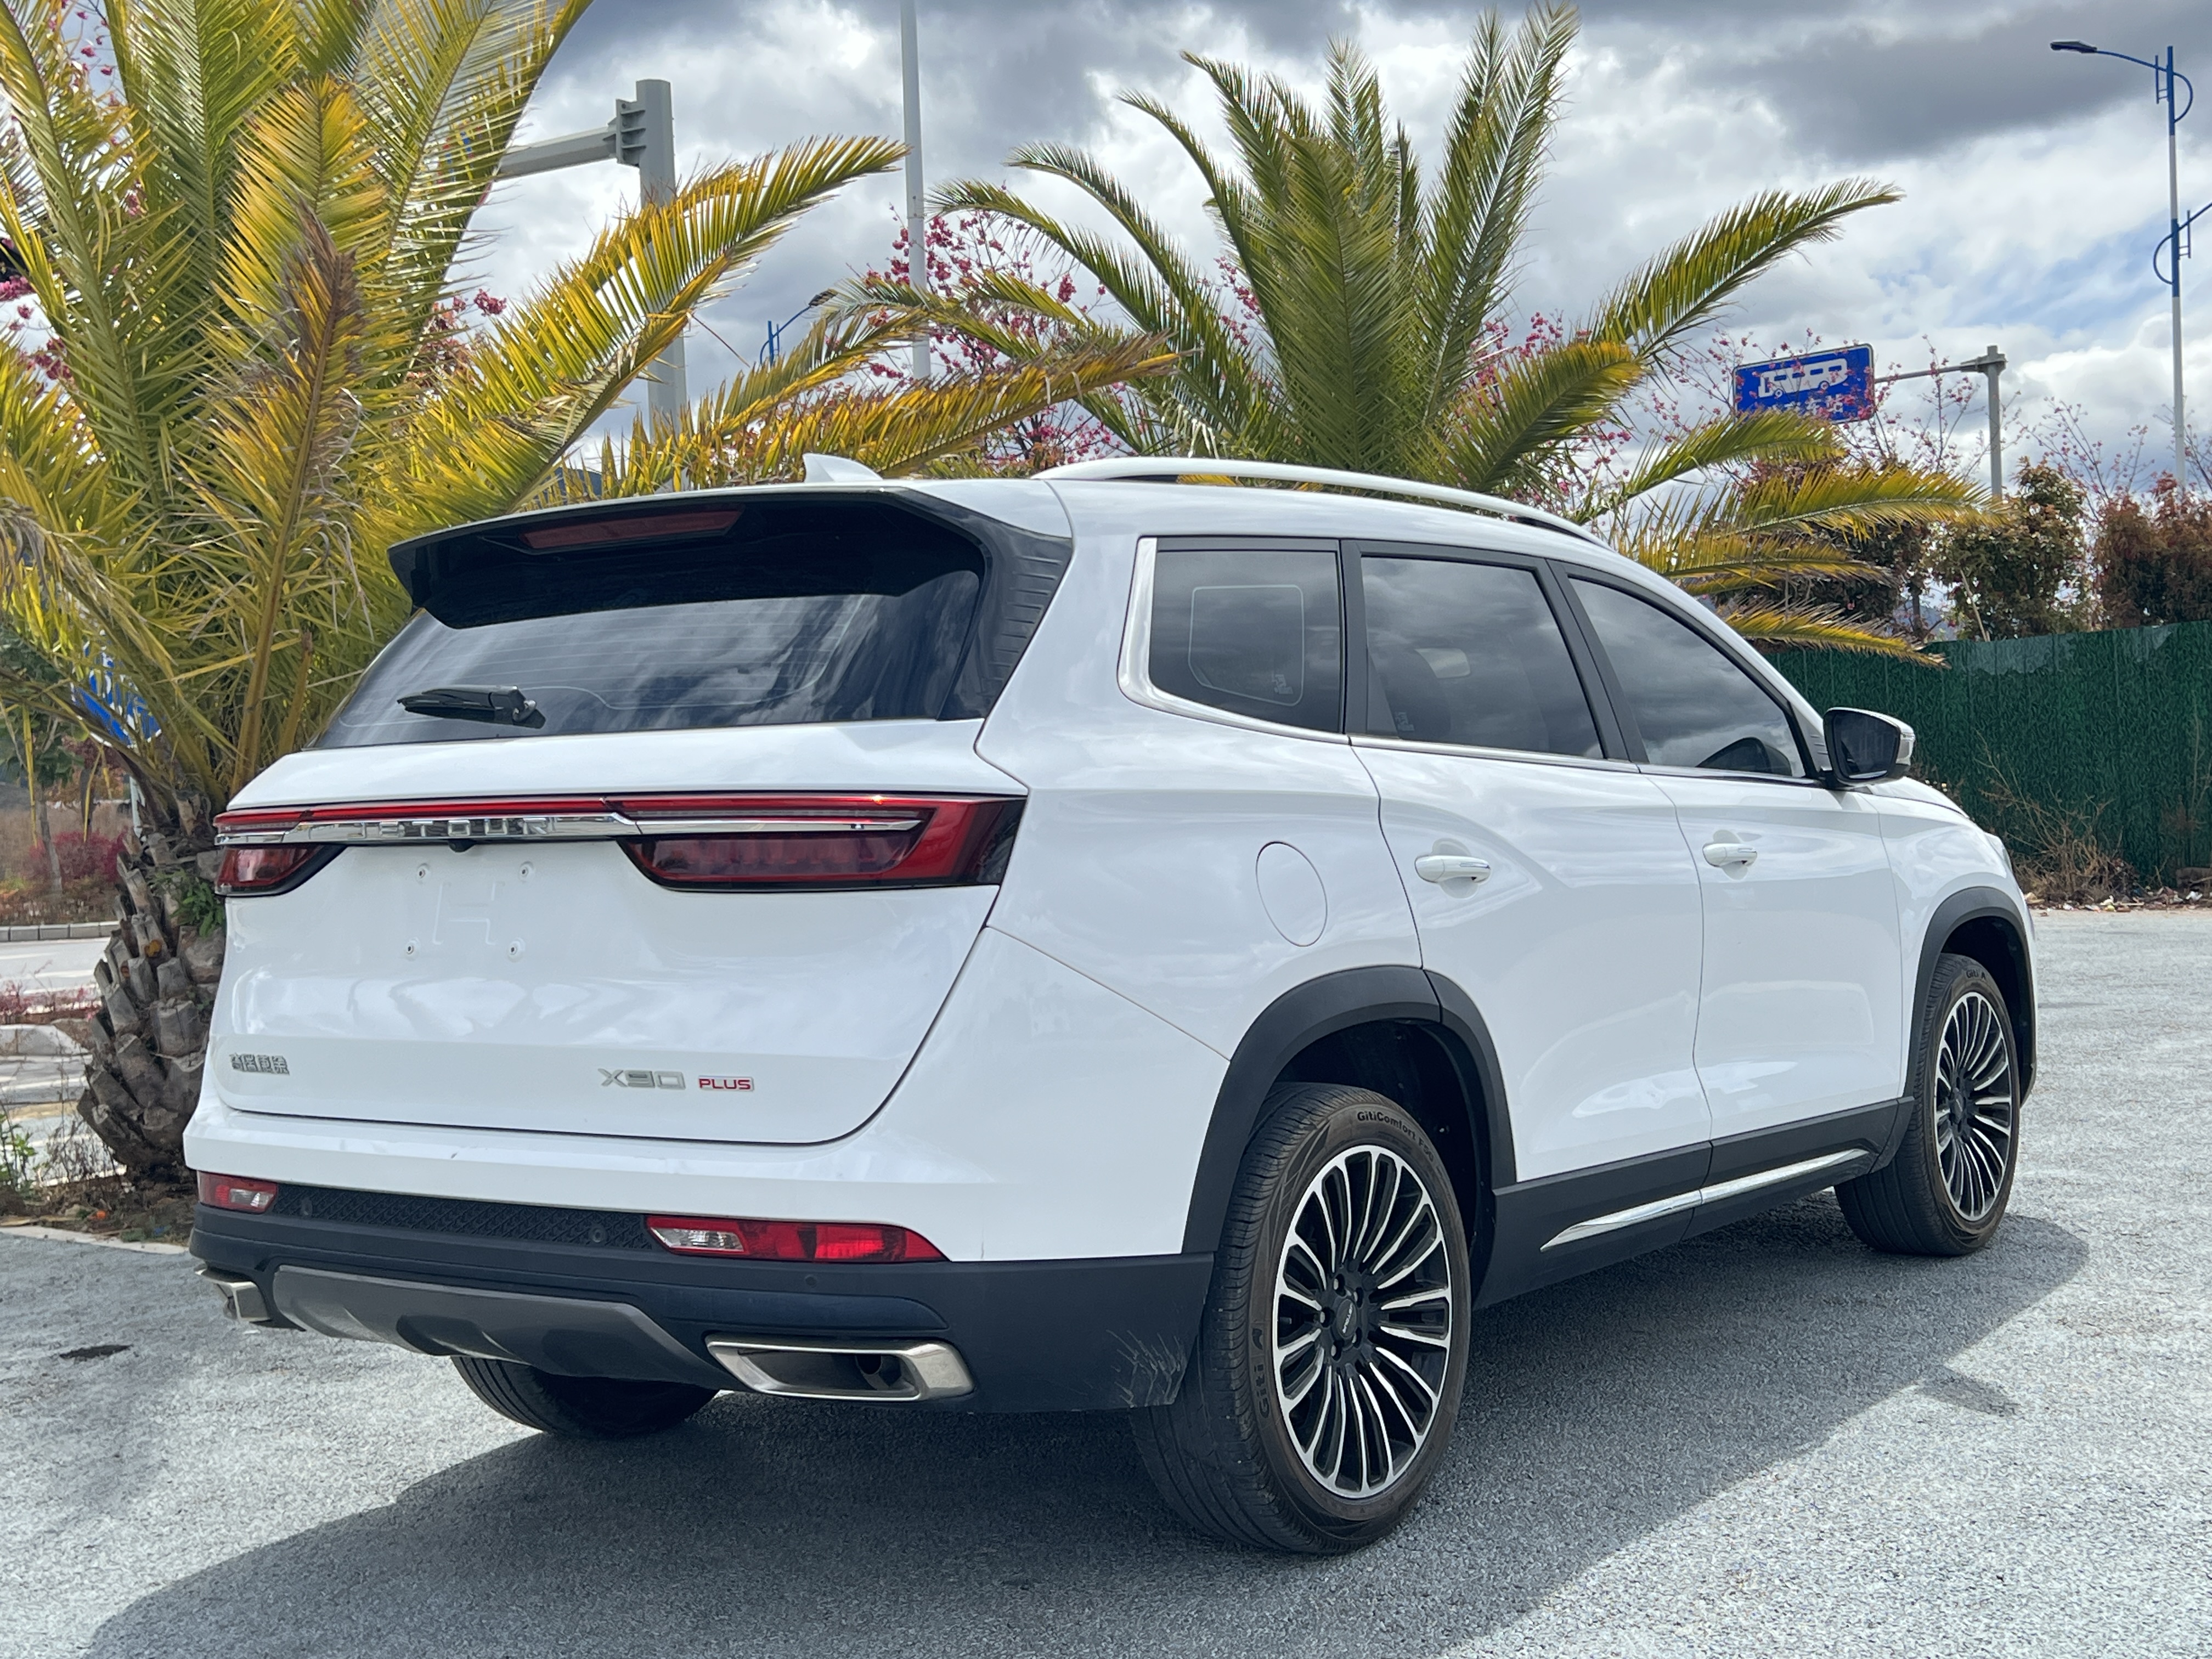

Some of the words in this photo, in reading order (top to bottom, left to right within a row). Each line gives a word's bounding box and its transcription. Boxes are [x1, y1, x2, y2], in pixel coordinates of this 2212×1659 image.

[347, 817, 547, 839] JETOUR
[598, 1068, 686, 1091] X90
[698, 1078, 752, 1090] PLUS
[1357, 1111, 1416, 1141] GitiComfort
[1254, 1364, 1269, 1418] Giti
